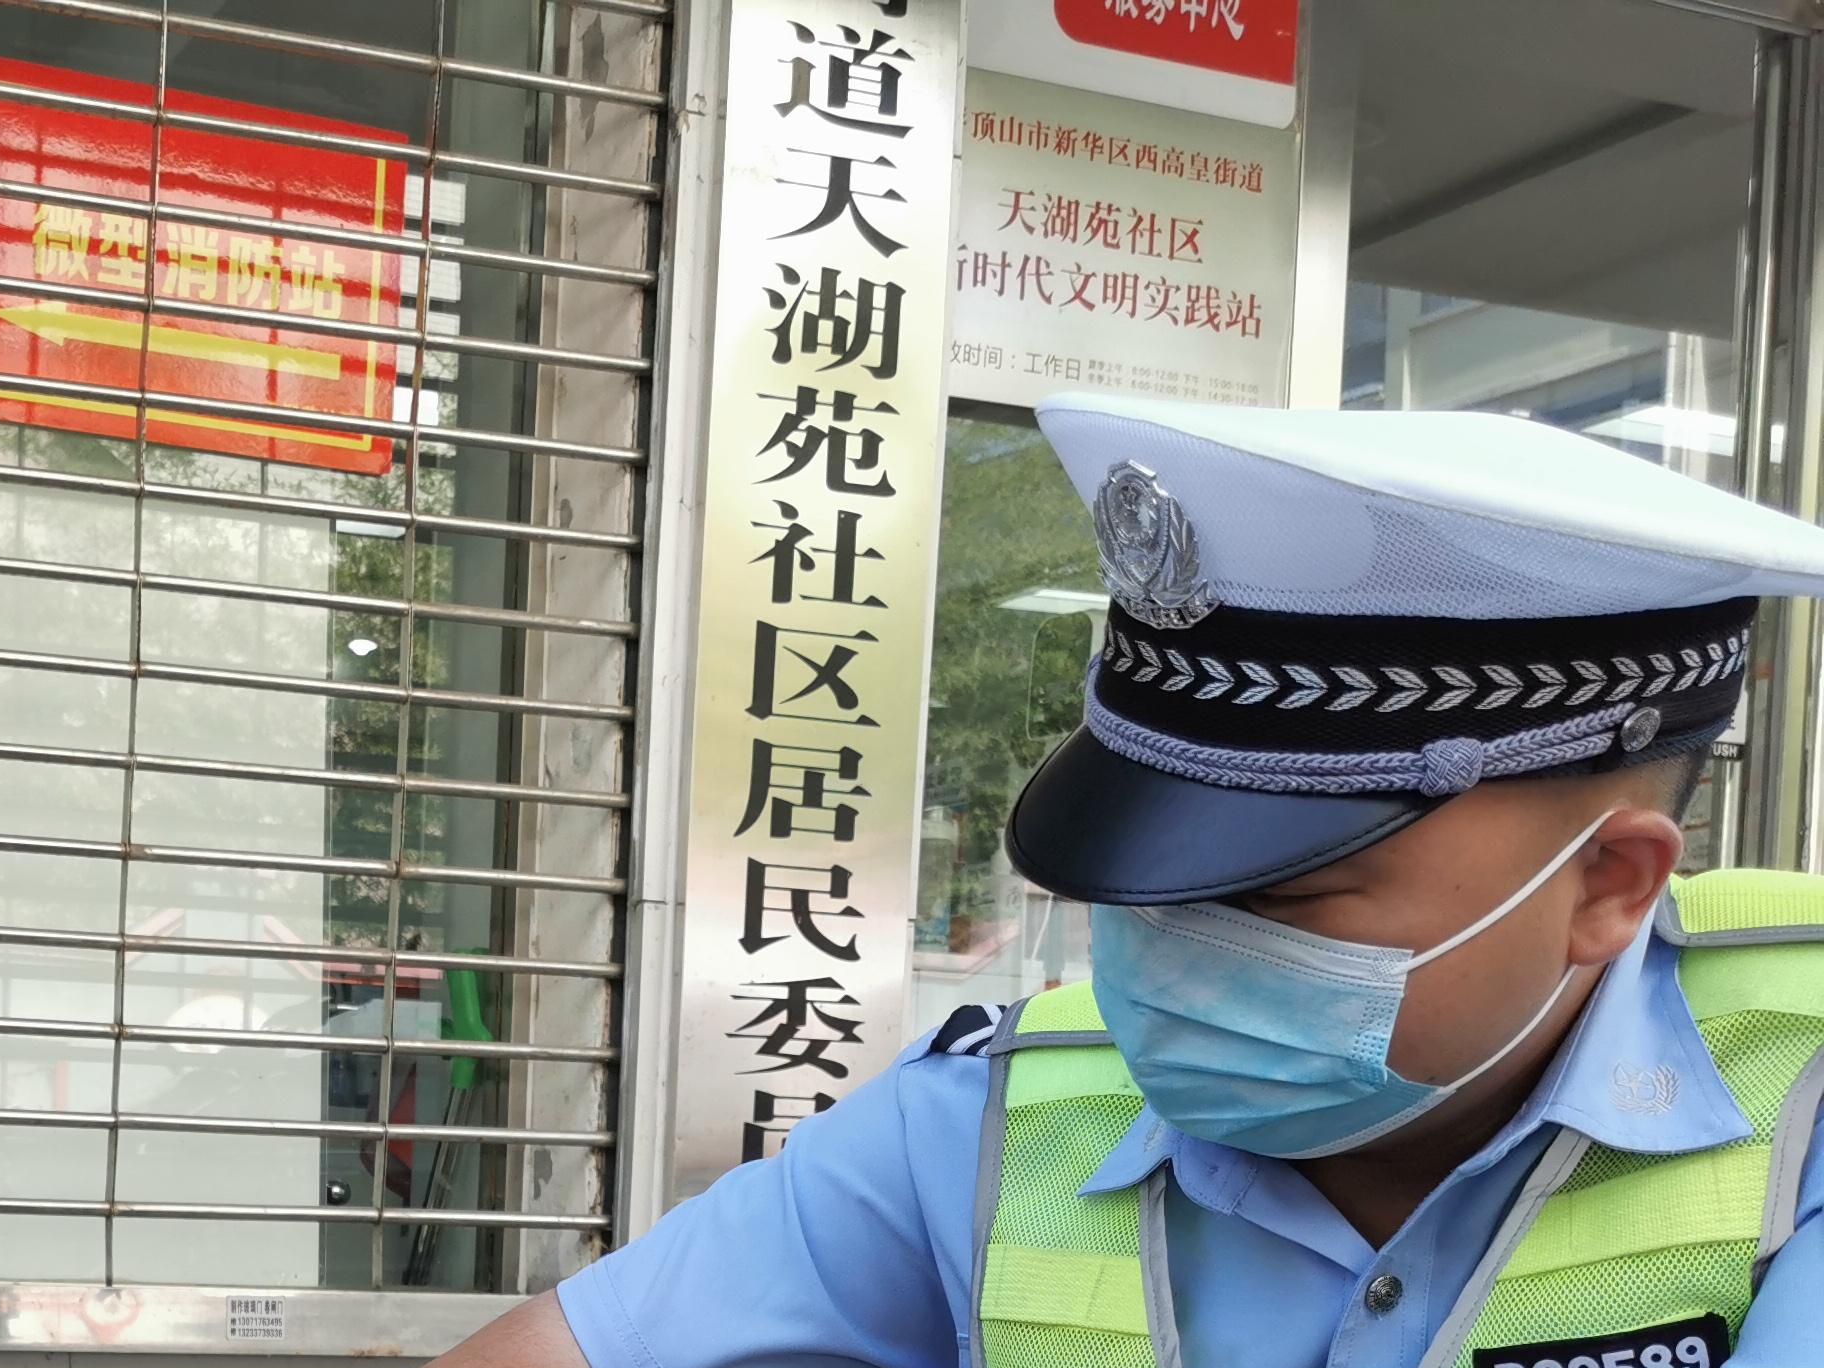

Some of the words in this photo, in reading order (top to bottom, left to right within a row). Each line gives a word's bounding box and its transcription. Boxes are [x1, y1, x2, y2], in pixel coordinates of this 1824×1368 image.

[963, 107, 1264, 193] 顶山市新华区西高皇街道
[33, 202, 345, 320] 微型消防站
[997, 188, 1204, 264] 天湖苑社区
[725, 0, 915, 1162] 道天湖苑社区居民委
